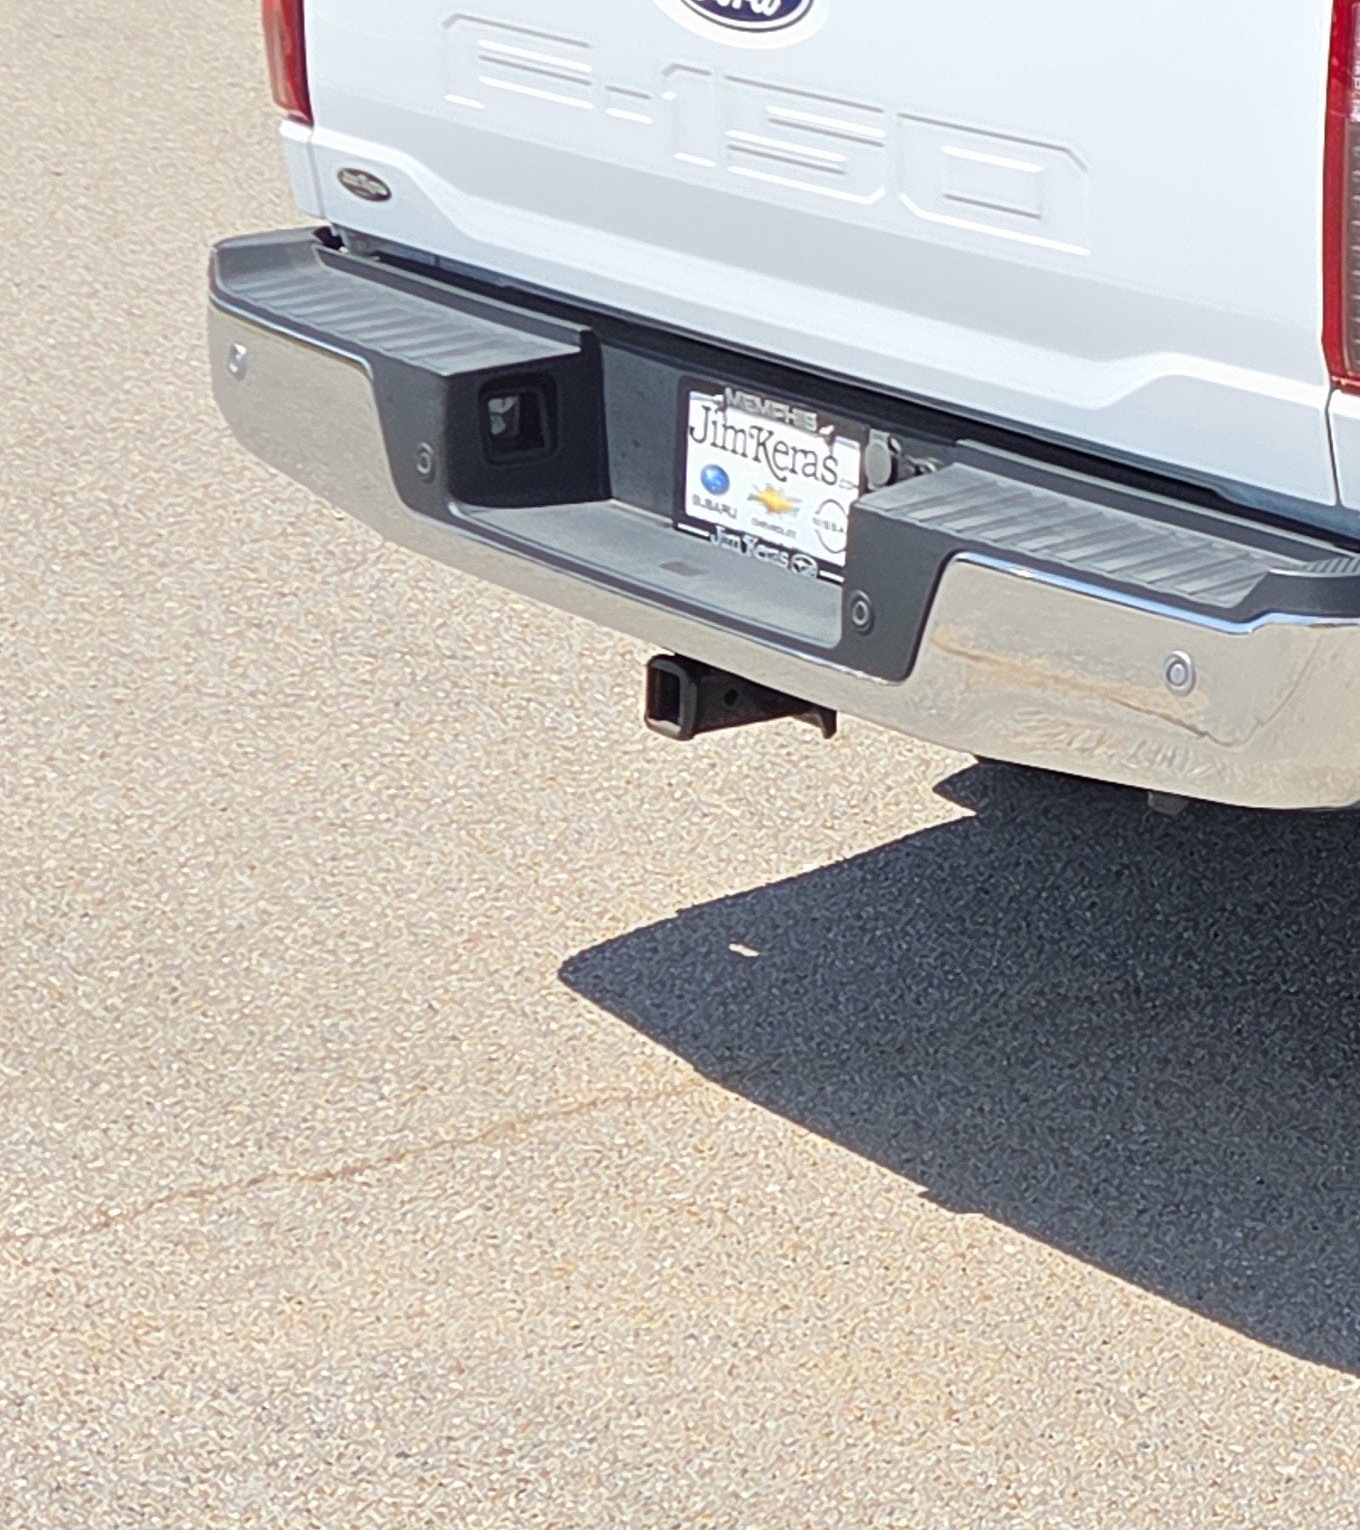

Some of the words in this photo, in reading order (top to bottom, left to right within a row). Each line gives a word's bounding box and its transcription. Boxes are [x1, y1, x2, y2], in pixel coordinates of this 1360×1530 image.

[443, 12, 1092, 257] F-150
[692, 493, 738, 520] SUBARU
[812, 516, 845, 534] NISSA
